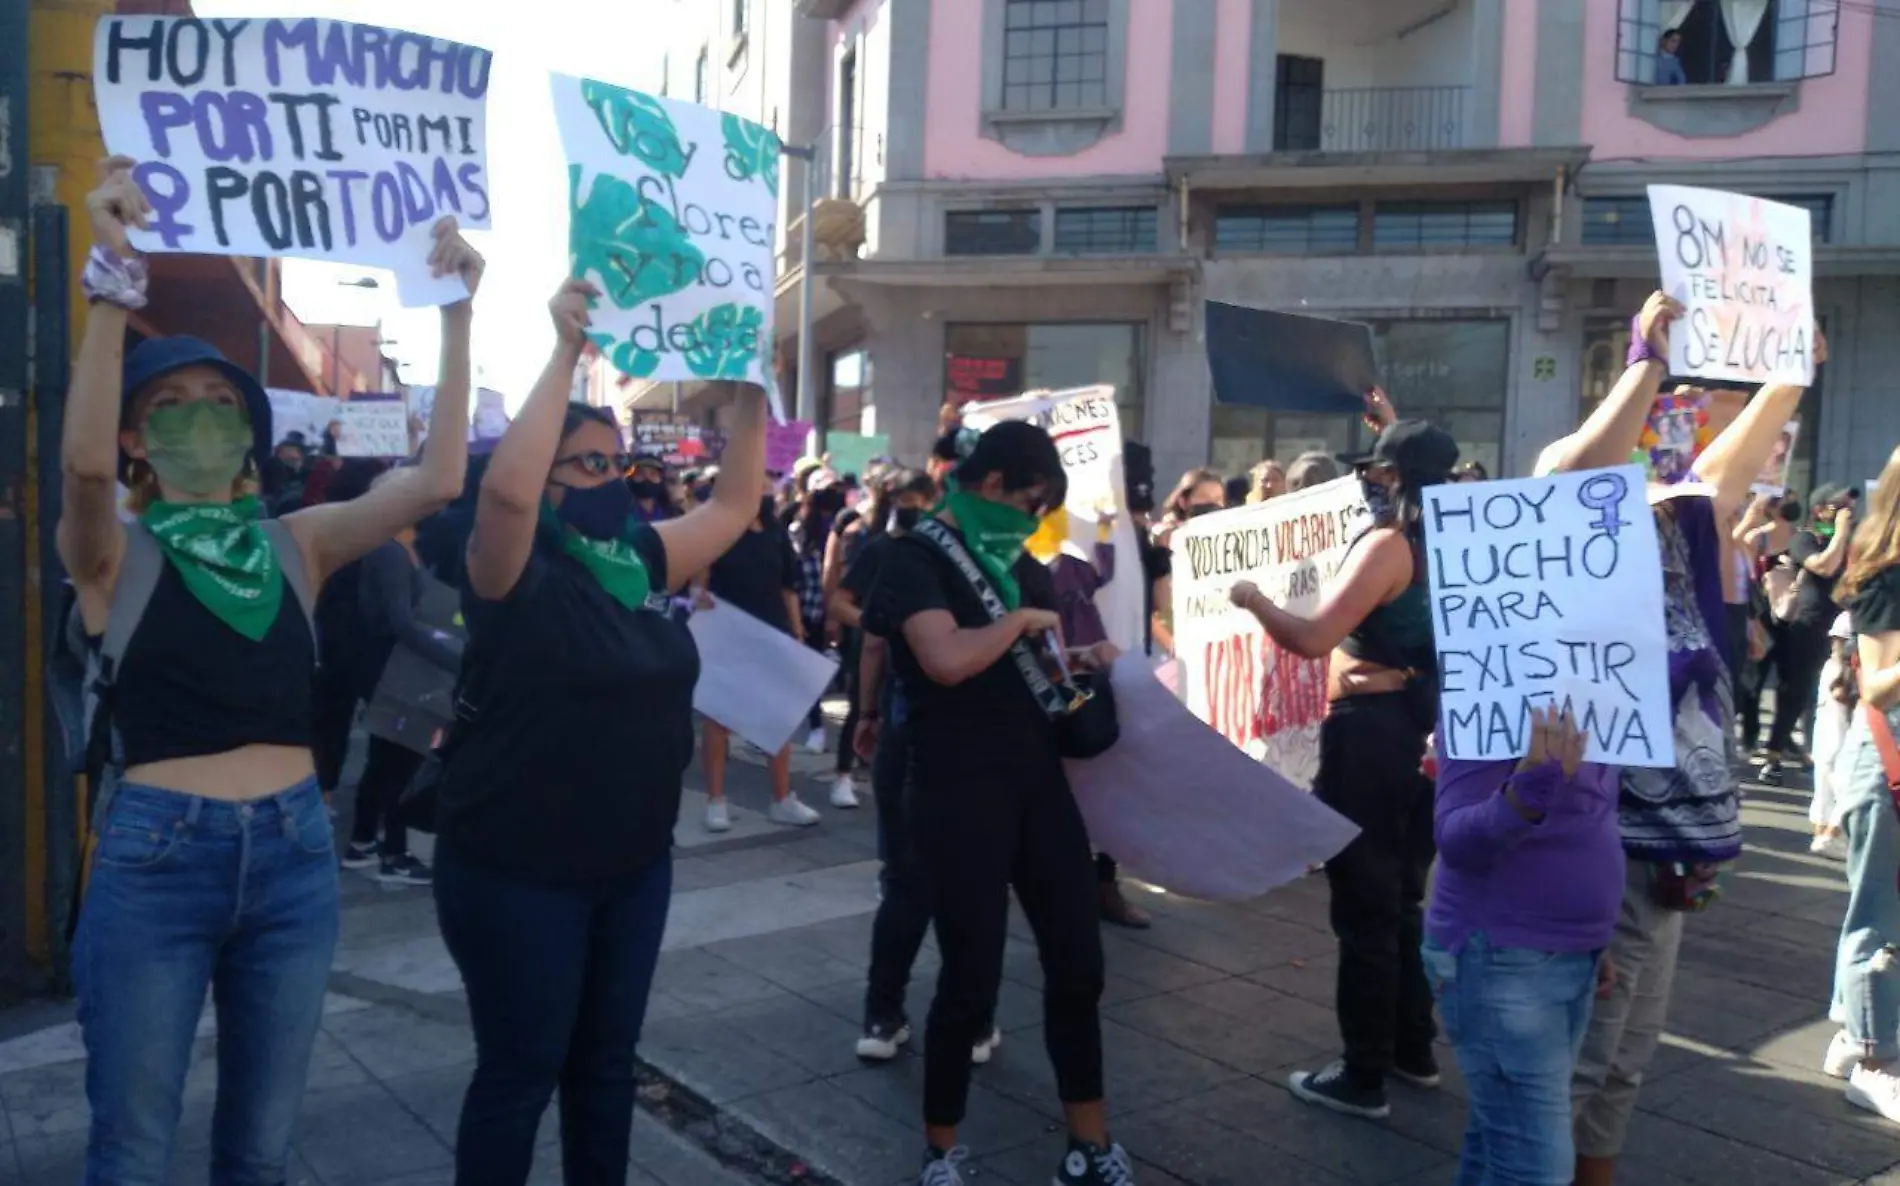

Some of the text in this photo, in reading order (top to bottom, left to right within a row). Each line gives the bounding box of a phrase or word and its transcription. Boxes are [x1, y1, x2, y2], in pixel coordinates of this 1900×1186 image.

[107, 18, 493, 100] HOY MARCHO
[140, 90, 478, 163] POR TI POR MI
[204, 156, 490, 252] POR TODAS
[1672, 204, 1796, 274] 8M NO SE
[1724, 313, 1806, 371] LUCHA
[1062, 441, 1098, 467] CES
[1431, 484, 1555, 533] HOY
[1185, 527, 1271, 581] VIOLENCIA
[1275, 510, 1337, 565] VICARIA
[1435, 532, 1619, 589] LUCHO
[1439, 590, 1564, 637] PARA
[1440, 638, 1641, 702] EXISTIR
